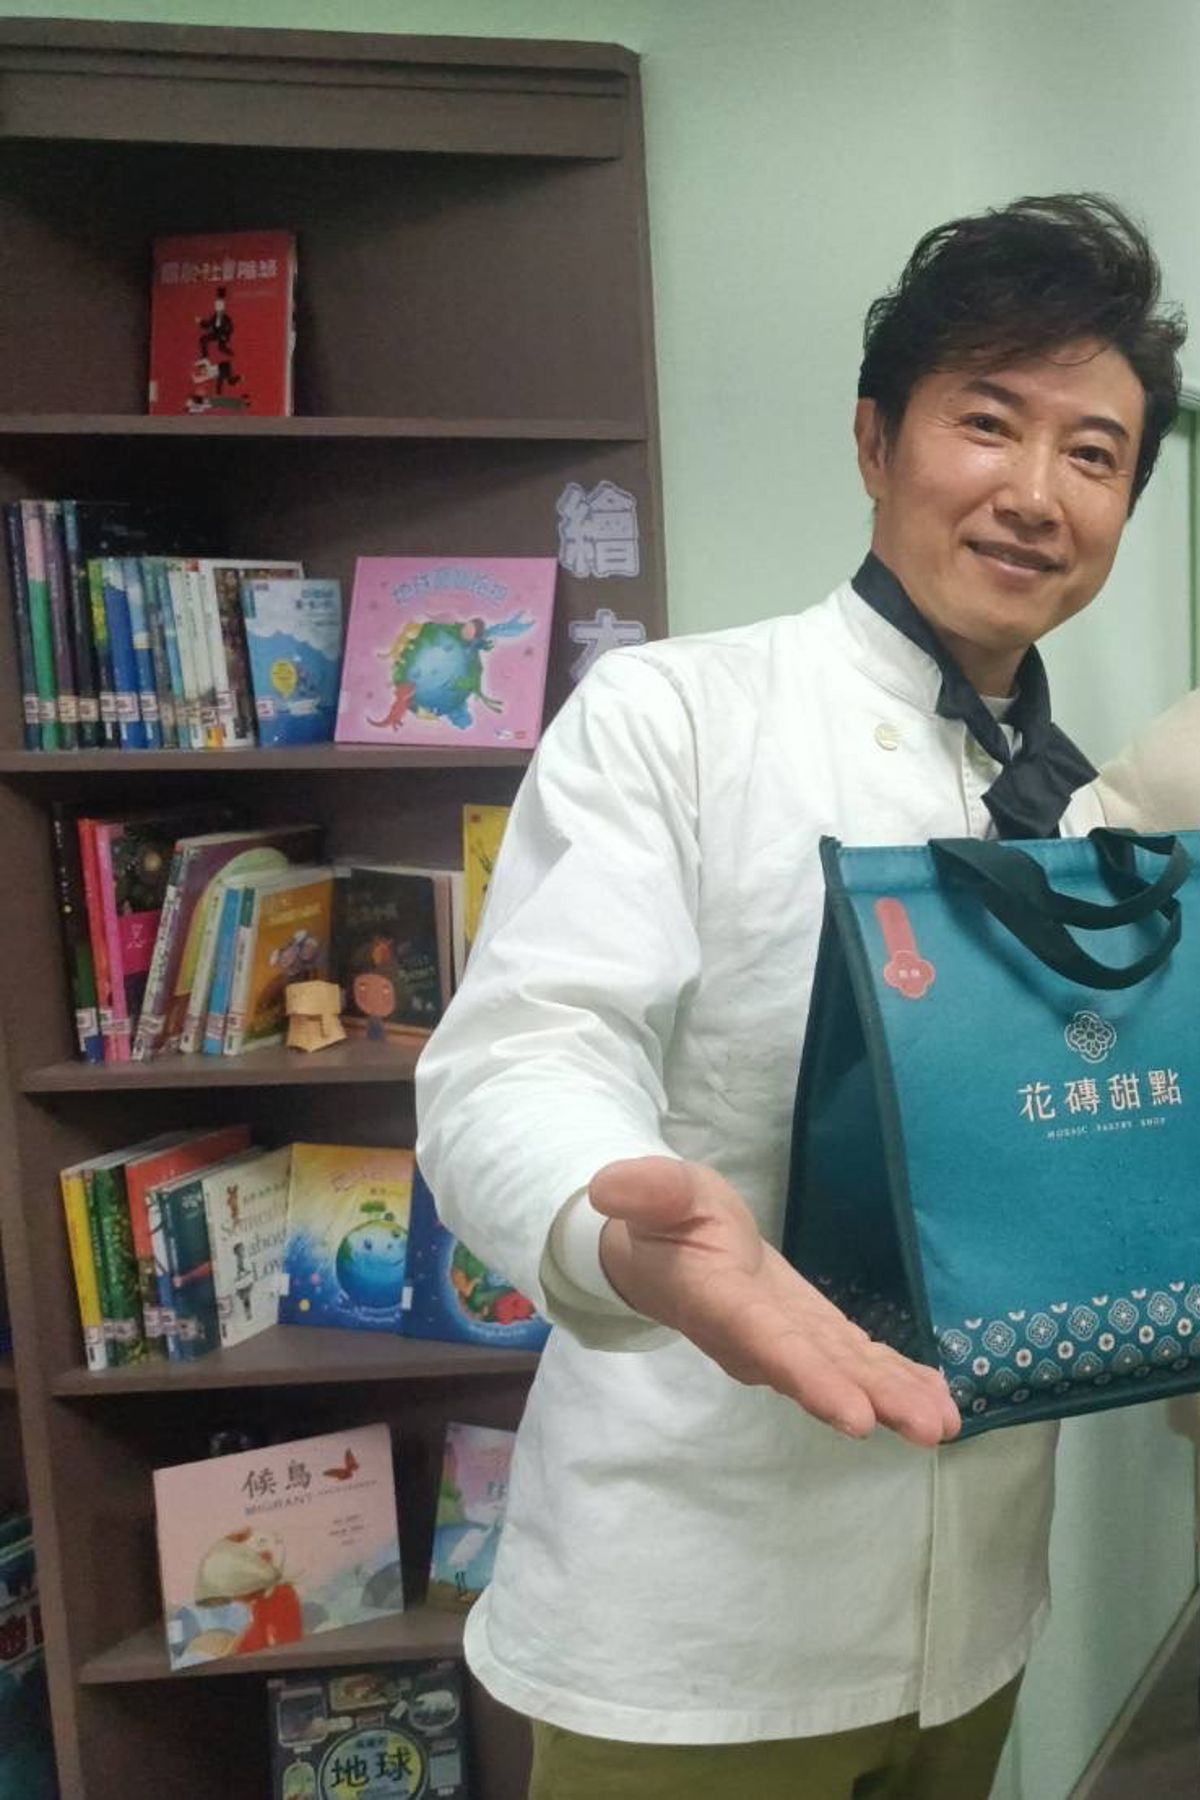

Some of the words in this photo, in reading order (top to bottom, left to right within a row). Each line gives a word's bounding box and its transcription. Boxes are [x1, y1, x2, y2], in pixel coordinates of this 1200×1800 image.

[1017, 1068, 1183, 1122] 花磚甜點
[241, 1459, 312, 1498] 候鳥
[330, 1746, 412, 1788] 地球
